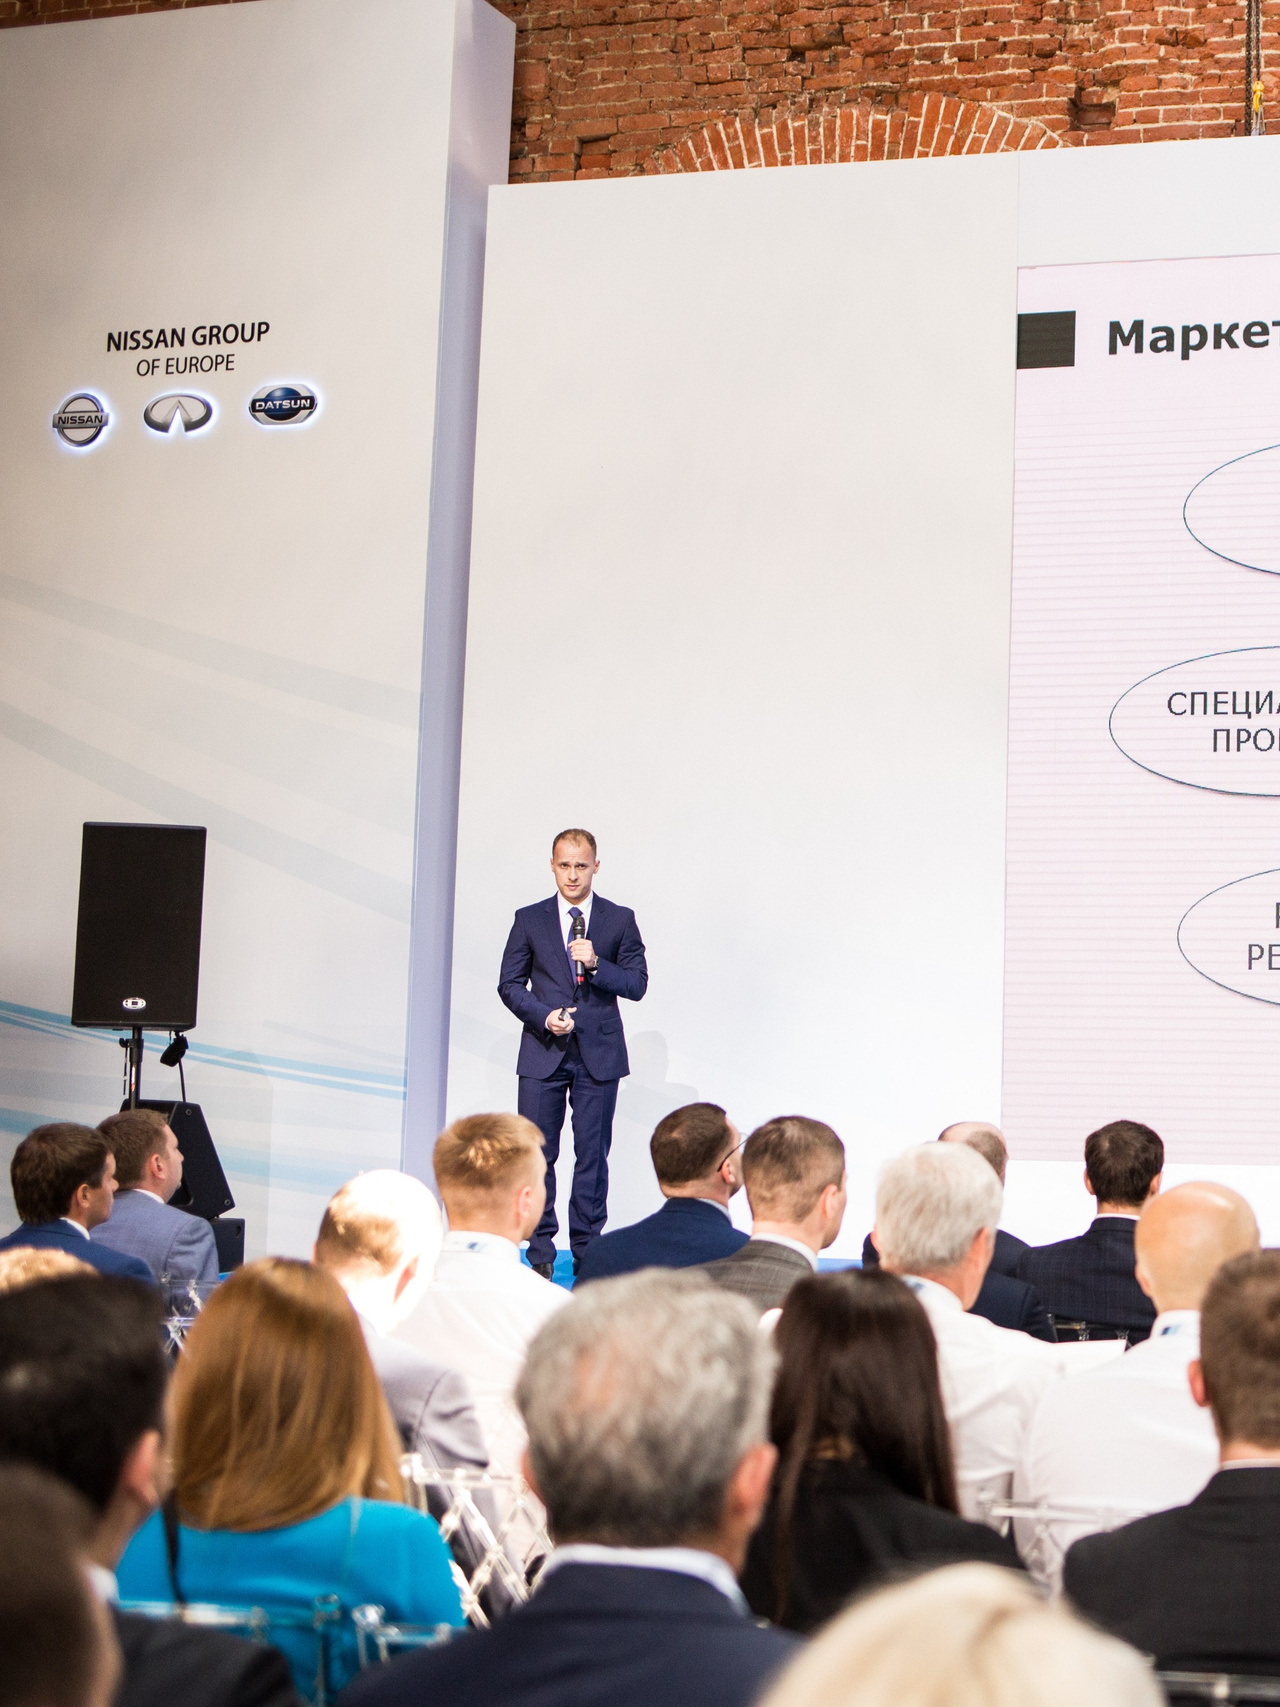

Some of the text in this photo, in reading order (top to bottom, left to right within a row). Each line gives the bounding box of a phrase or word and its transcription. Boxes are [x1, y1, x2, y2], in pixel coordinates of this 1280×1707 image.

[106, 321, 270, 352] NISSAN GROUP
[136, 353, 235, 377] OF EUROPE
[255, 398, 311, 411] DATSUN
[57, 414, 104, 425] NISSAN
